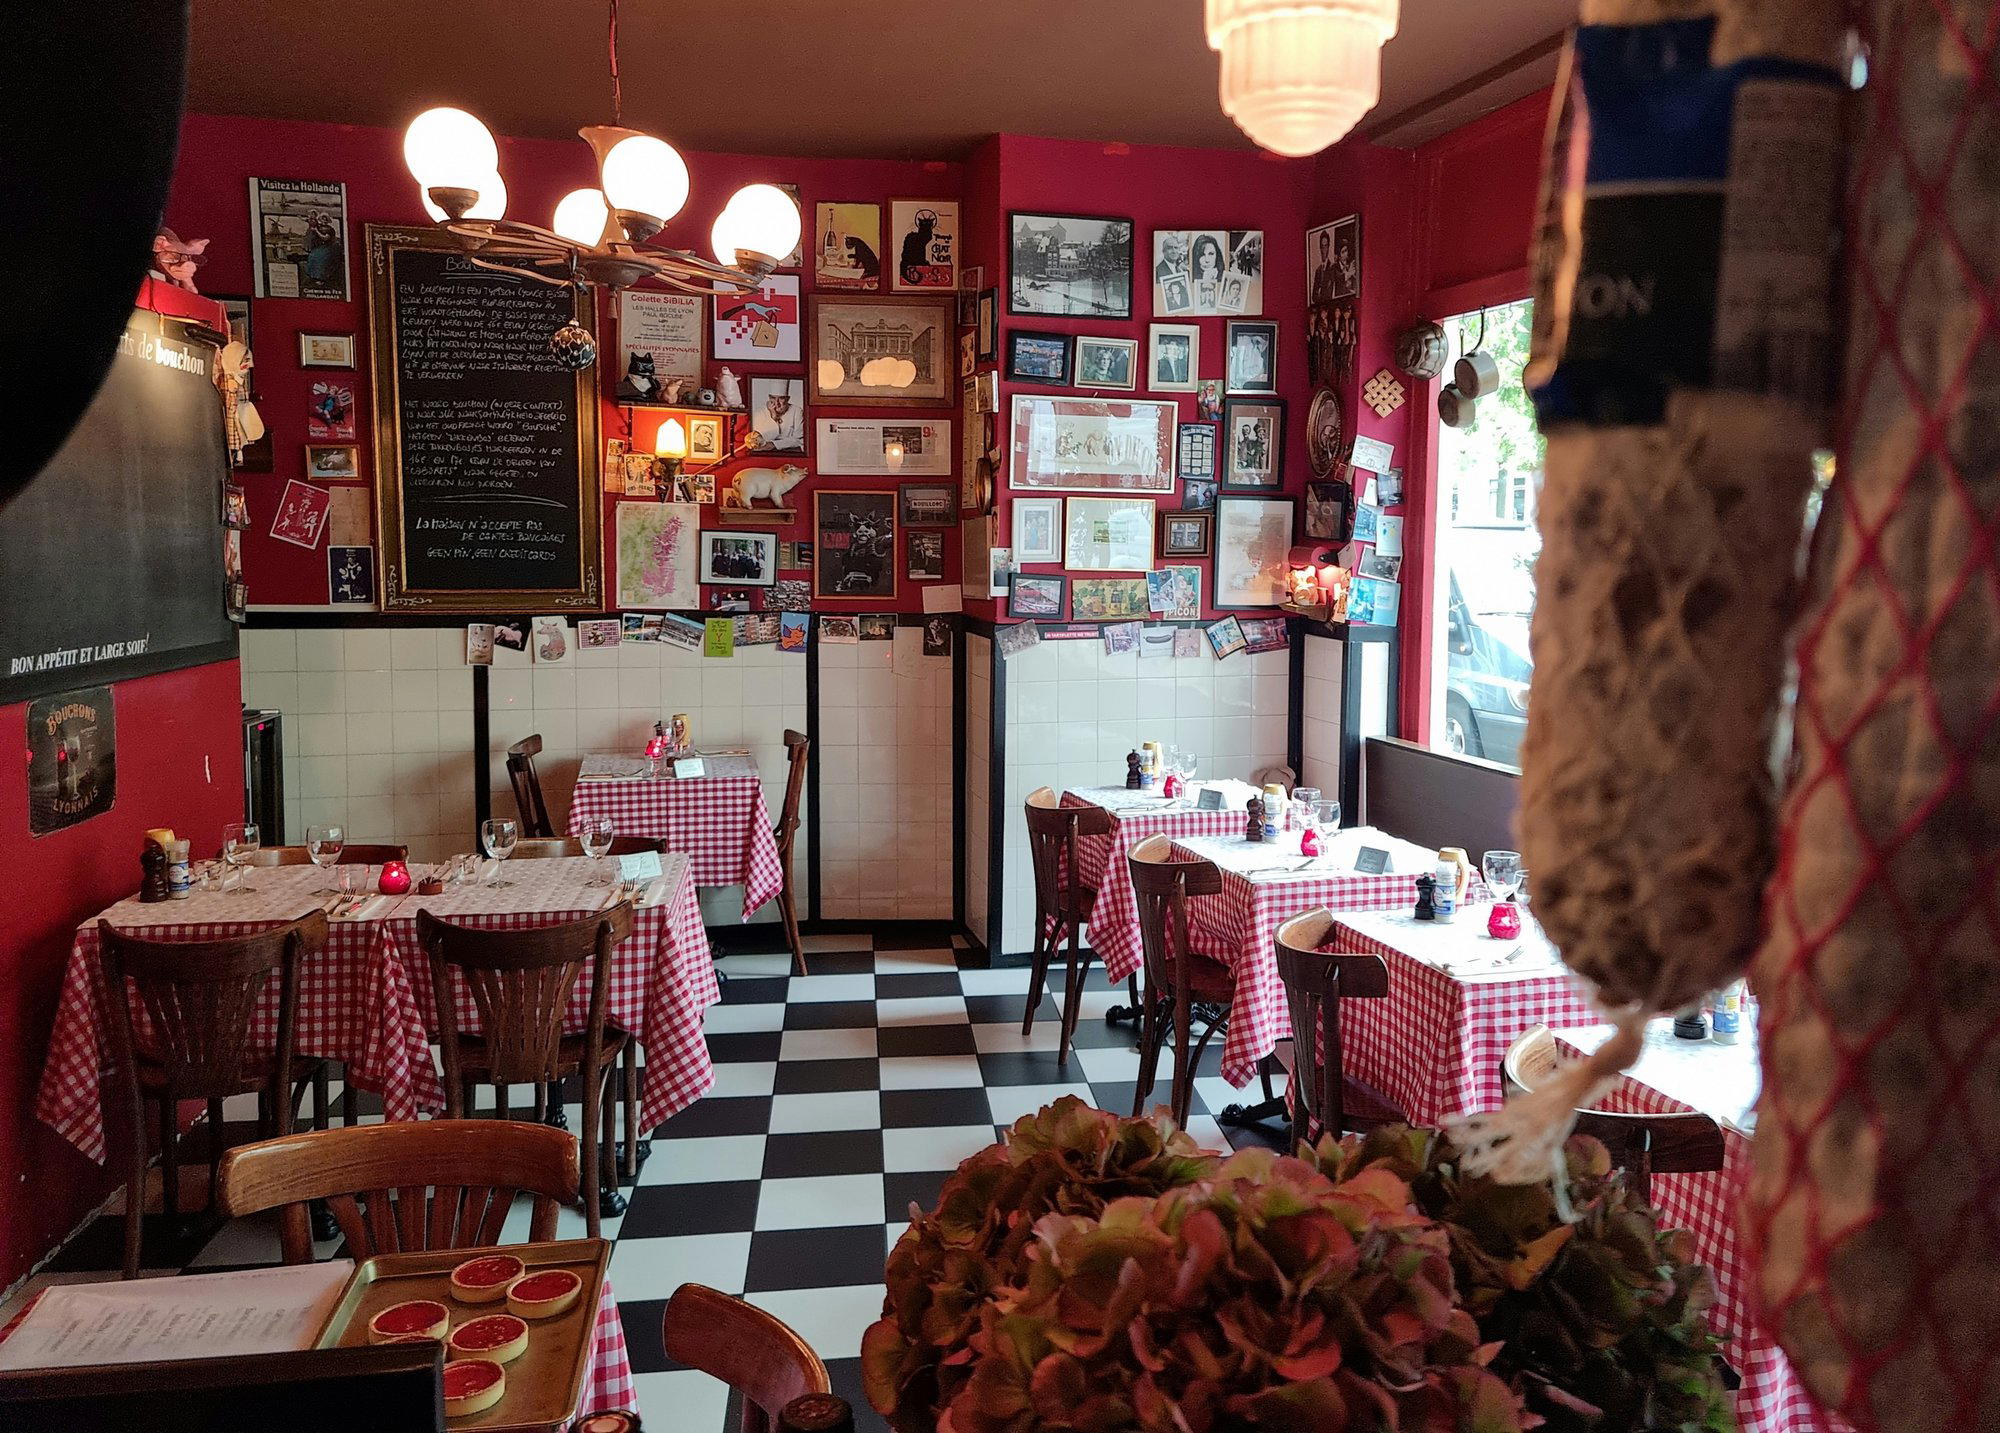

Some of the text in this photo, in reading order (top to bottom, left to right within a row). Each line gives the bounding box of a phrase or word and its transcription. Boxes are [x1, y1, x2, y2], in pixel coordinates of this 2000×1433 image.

[261, 180, 290, 190] Visitez
[301, 182, 339, 193] Hollande
[631, 294, 661, 303] Colette
[138, 333, 153, 361] de
[155, 338, 205, 376] bouchon
[1169, 607, 1196, 616] PICON
[11, 632, 150, 675] BON APPÉTIT ET LARGE SOIF!
[53, 785, 99, 814] LYONNAIS
